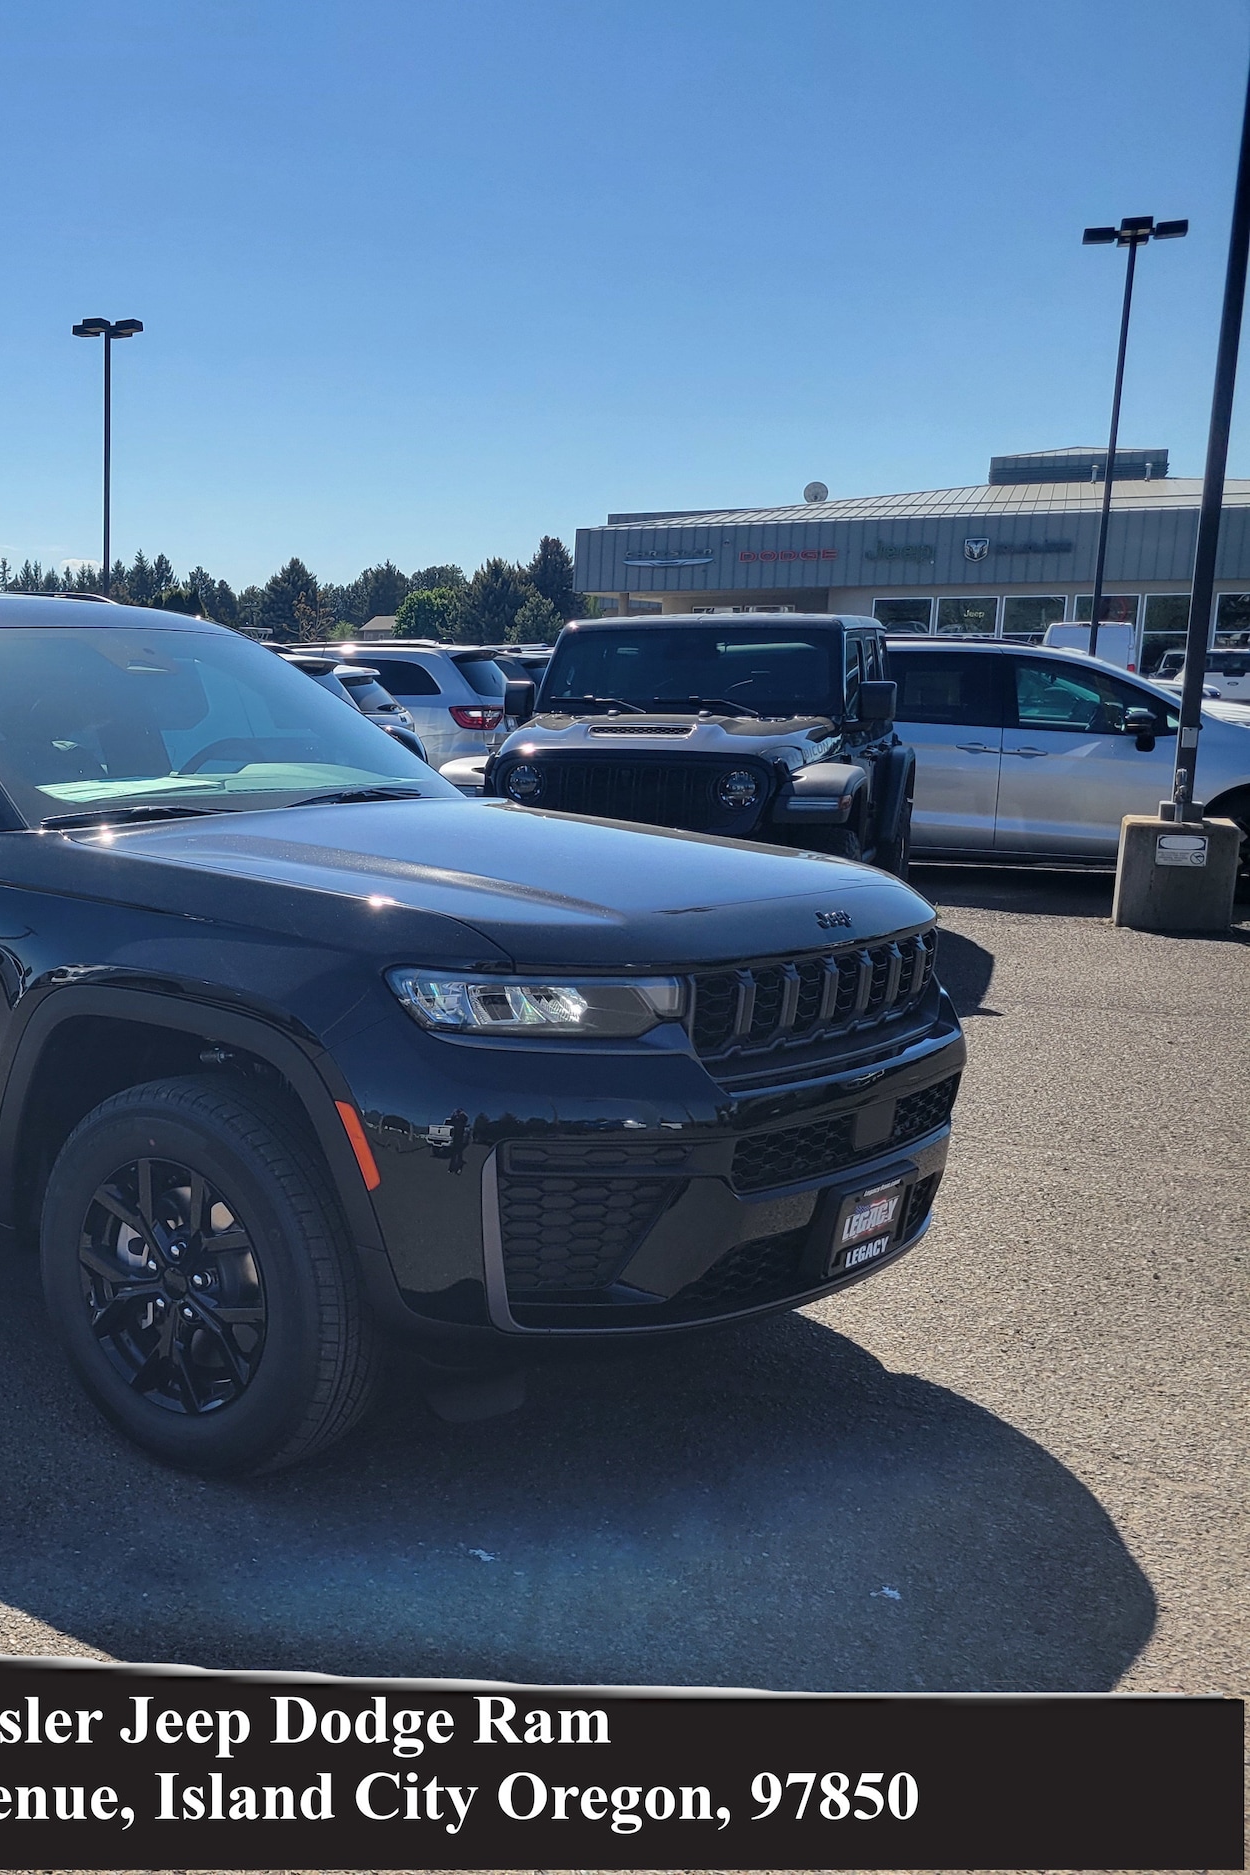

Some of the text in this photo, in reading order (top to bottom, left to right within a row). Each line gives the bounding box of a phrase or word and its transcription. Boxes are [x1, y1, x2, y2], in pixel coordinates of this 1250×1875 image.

[739, 549, 838, 562] DODGE
[864, 540, 935, 565] Jeep
[963, 609, 985, 619] Jeep
[842, 1197, 899, 1242] LEGACY
[845, 1235, 890, 1268] LEGACY
